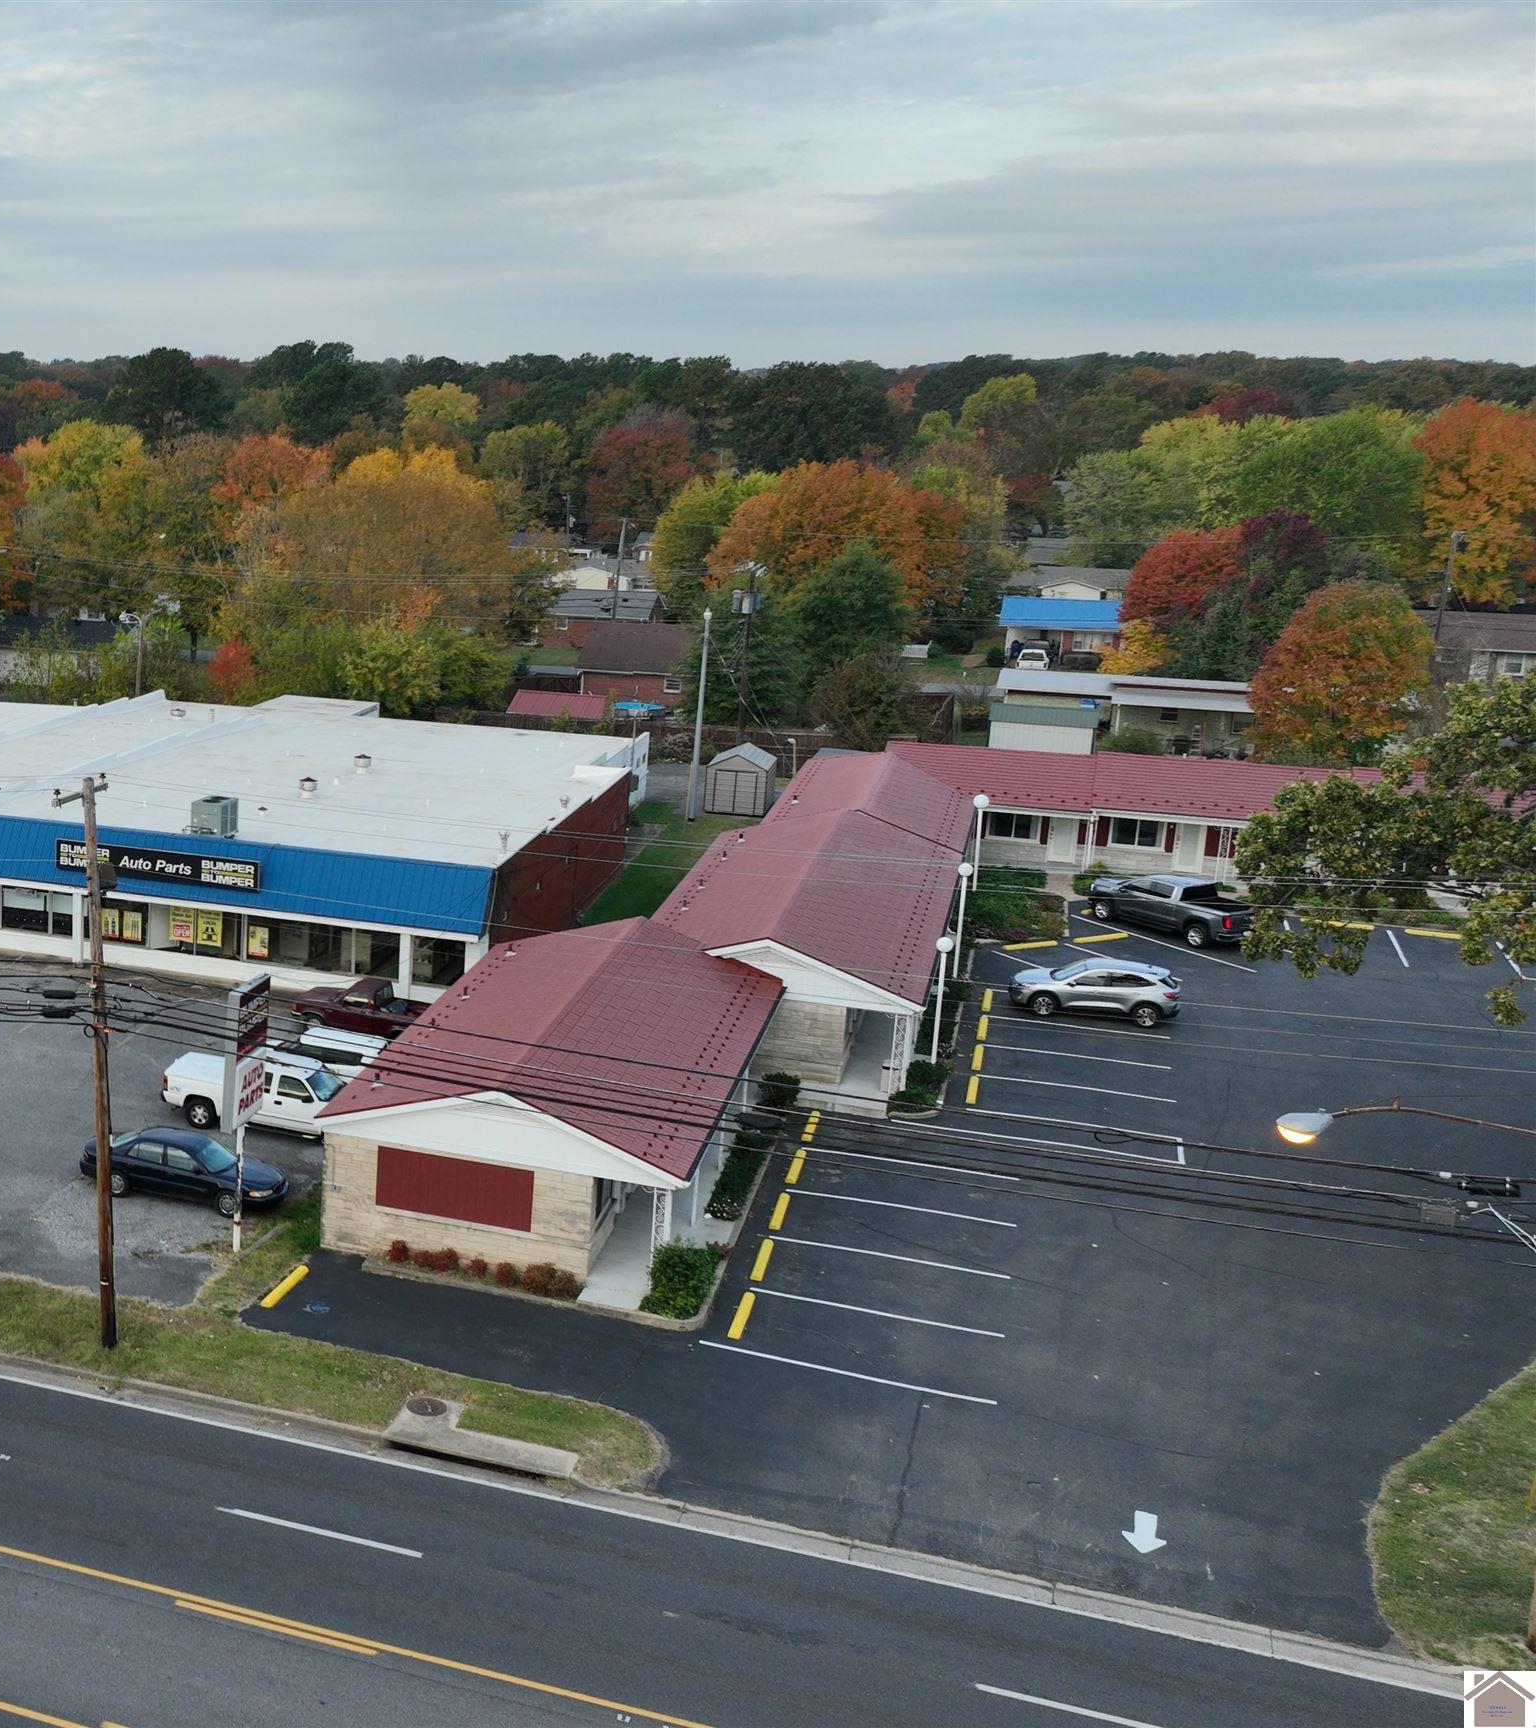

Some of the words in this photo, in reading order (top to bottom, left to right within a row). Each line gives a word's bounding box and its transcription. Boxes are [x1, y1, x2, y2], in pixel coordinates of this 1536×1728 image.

[60, 843, 110, 858] BUMER
[118, 855, 152, 870] Auto
[155, 859, 192, 875] Parts
[201, 859, 255, 875] BUMPER
[200, 873, 254, 888] BUMPER
[241, 1062, 263, 1092] AUTO
[237, 1082, 264, 1116] PARTS
